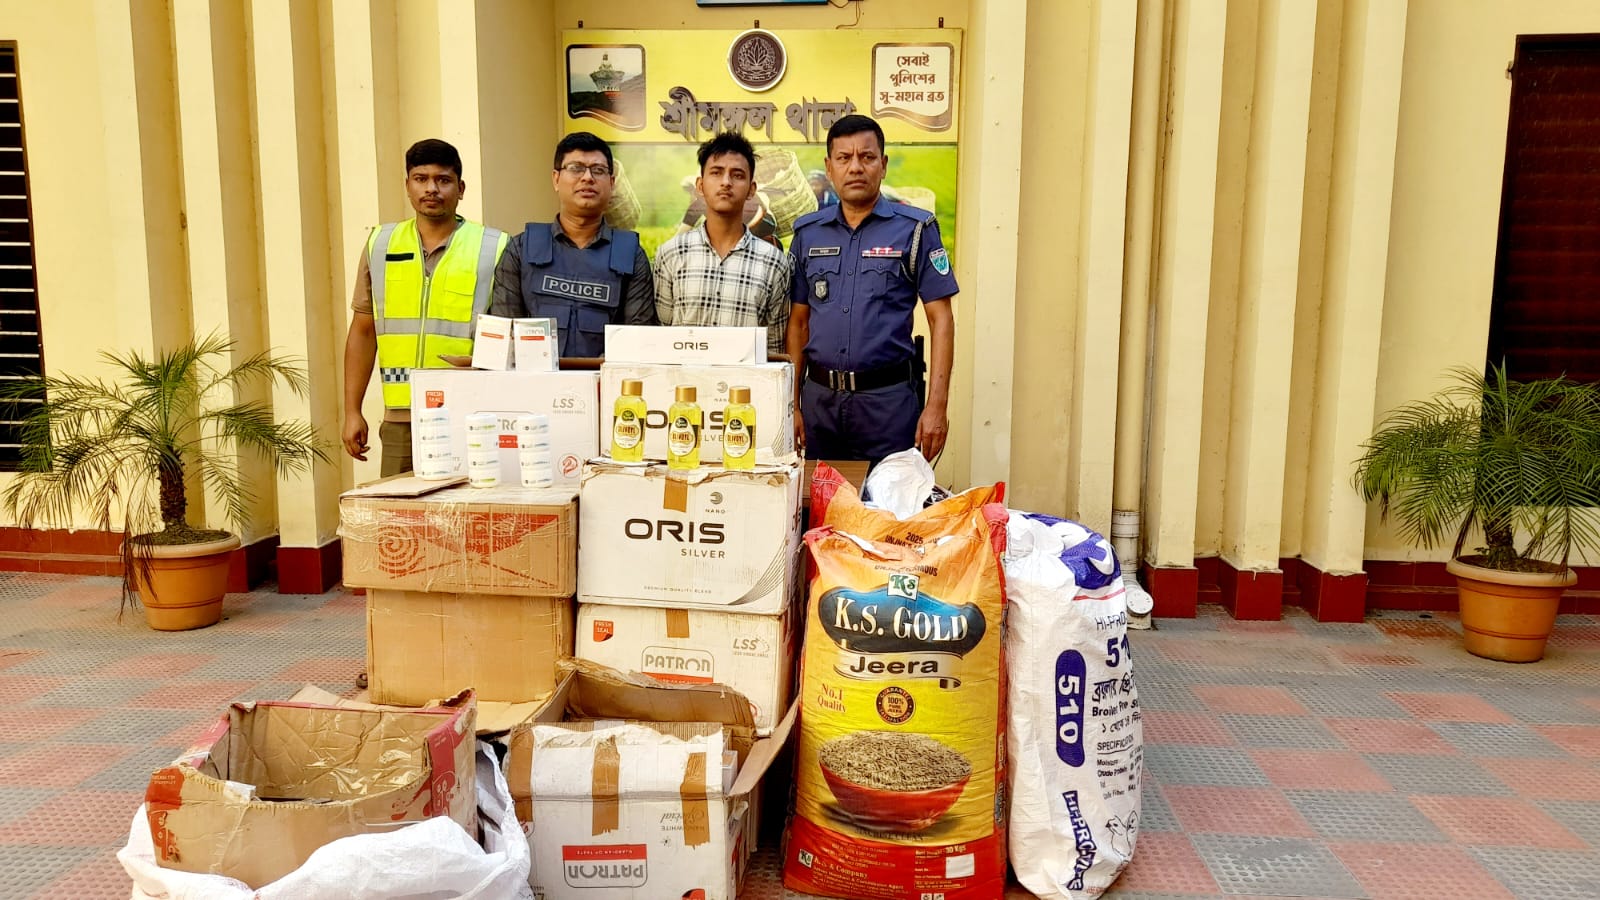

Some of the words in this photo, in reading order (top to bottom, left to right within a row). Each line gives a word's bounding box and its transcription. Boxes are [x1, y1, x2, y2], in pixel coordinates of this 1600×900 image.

[889, 69, 936, 87] পুলিশের
[548, 279, 603, 298] POLICE
[673, 341, 709, 351] ORIS
[552, 398, 575, 409] LSS
[624, 518, 725, 544] ORIS
[905, 532, 924, 544] 2025
[681, 548, 726, 559] SILVER
[833, 596, 884, 636] K.S.
[893, 606, 968, 642] GOLD
[732, 637, 758, 650] LSS
[644, 654, 711, 673] PATRON
[849, 656, 939, 675] Jeera
[817, 694, 846, 713] Quality
[1058, 674, 1081, 744] 510
[1092, 705, 1118, 717] Broiler
[568, 864, 644, 879] PATRON
